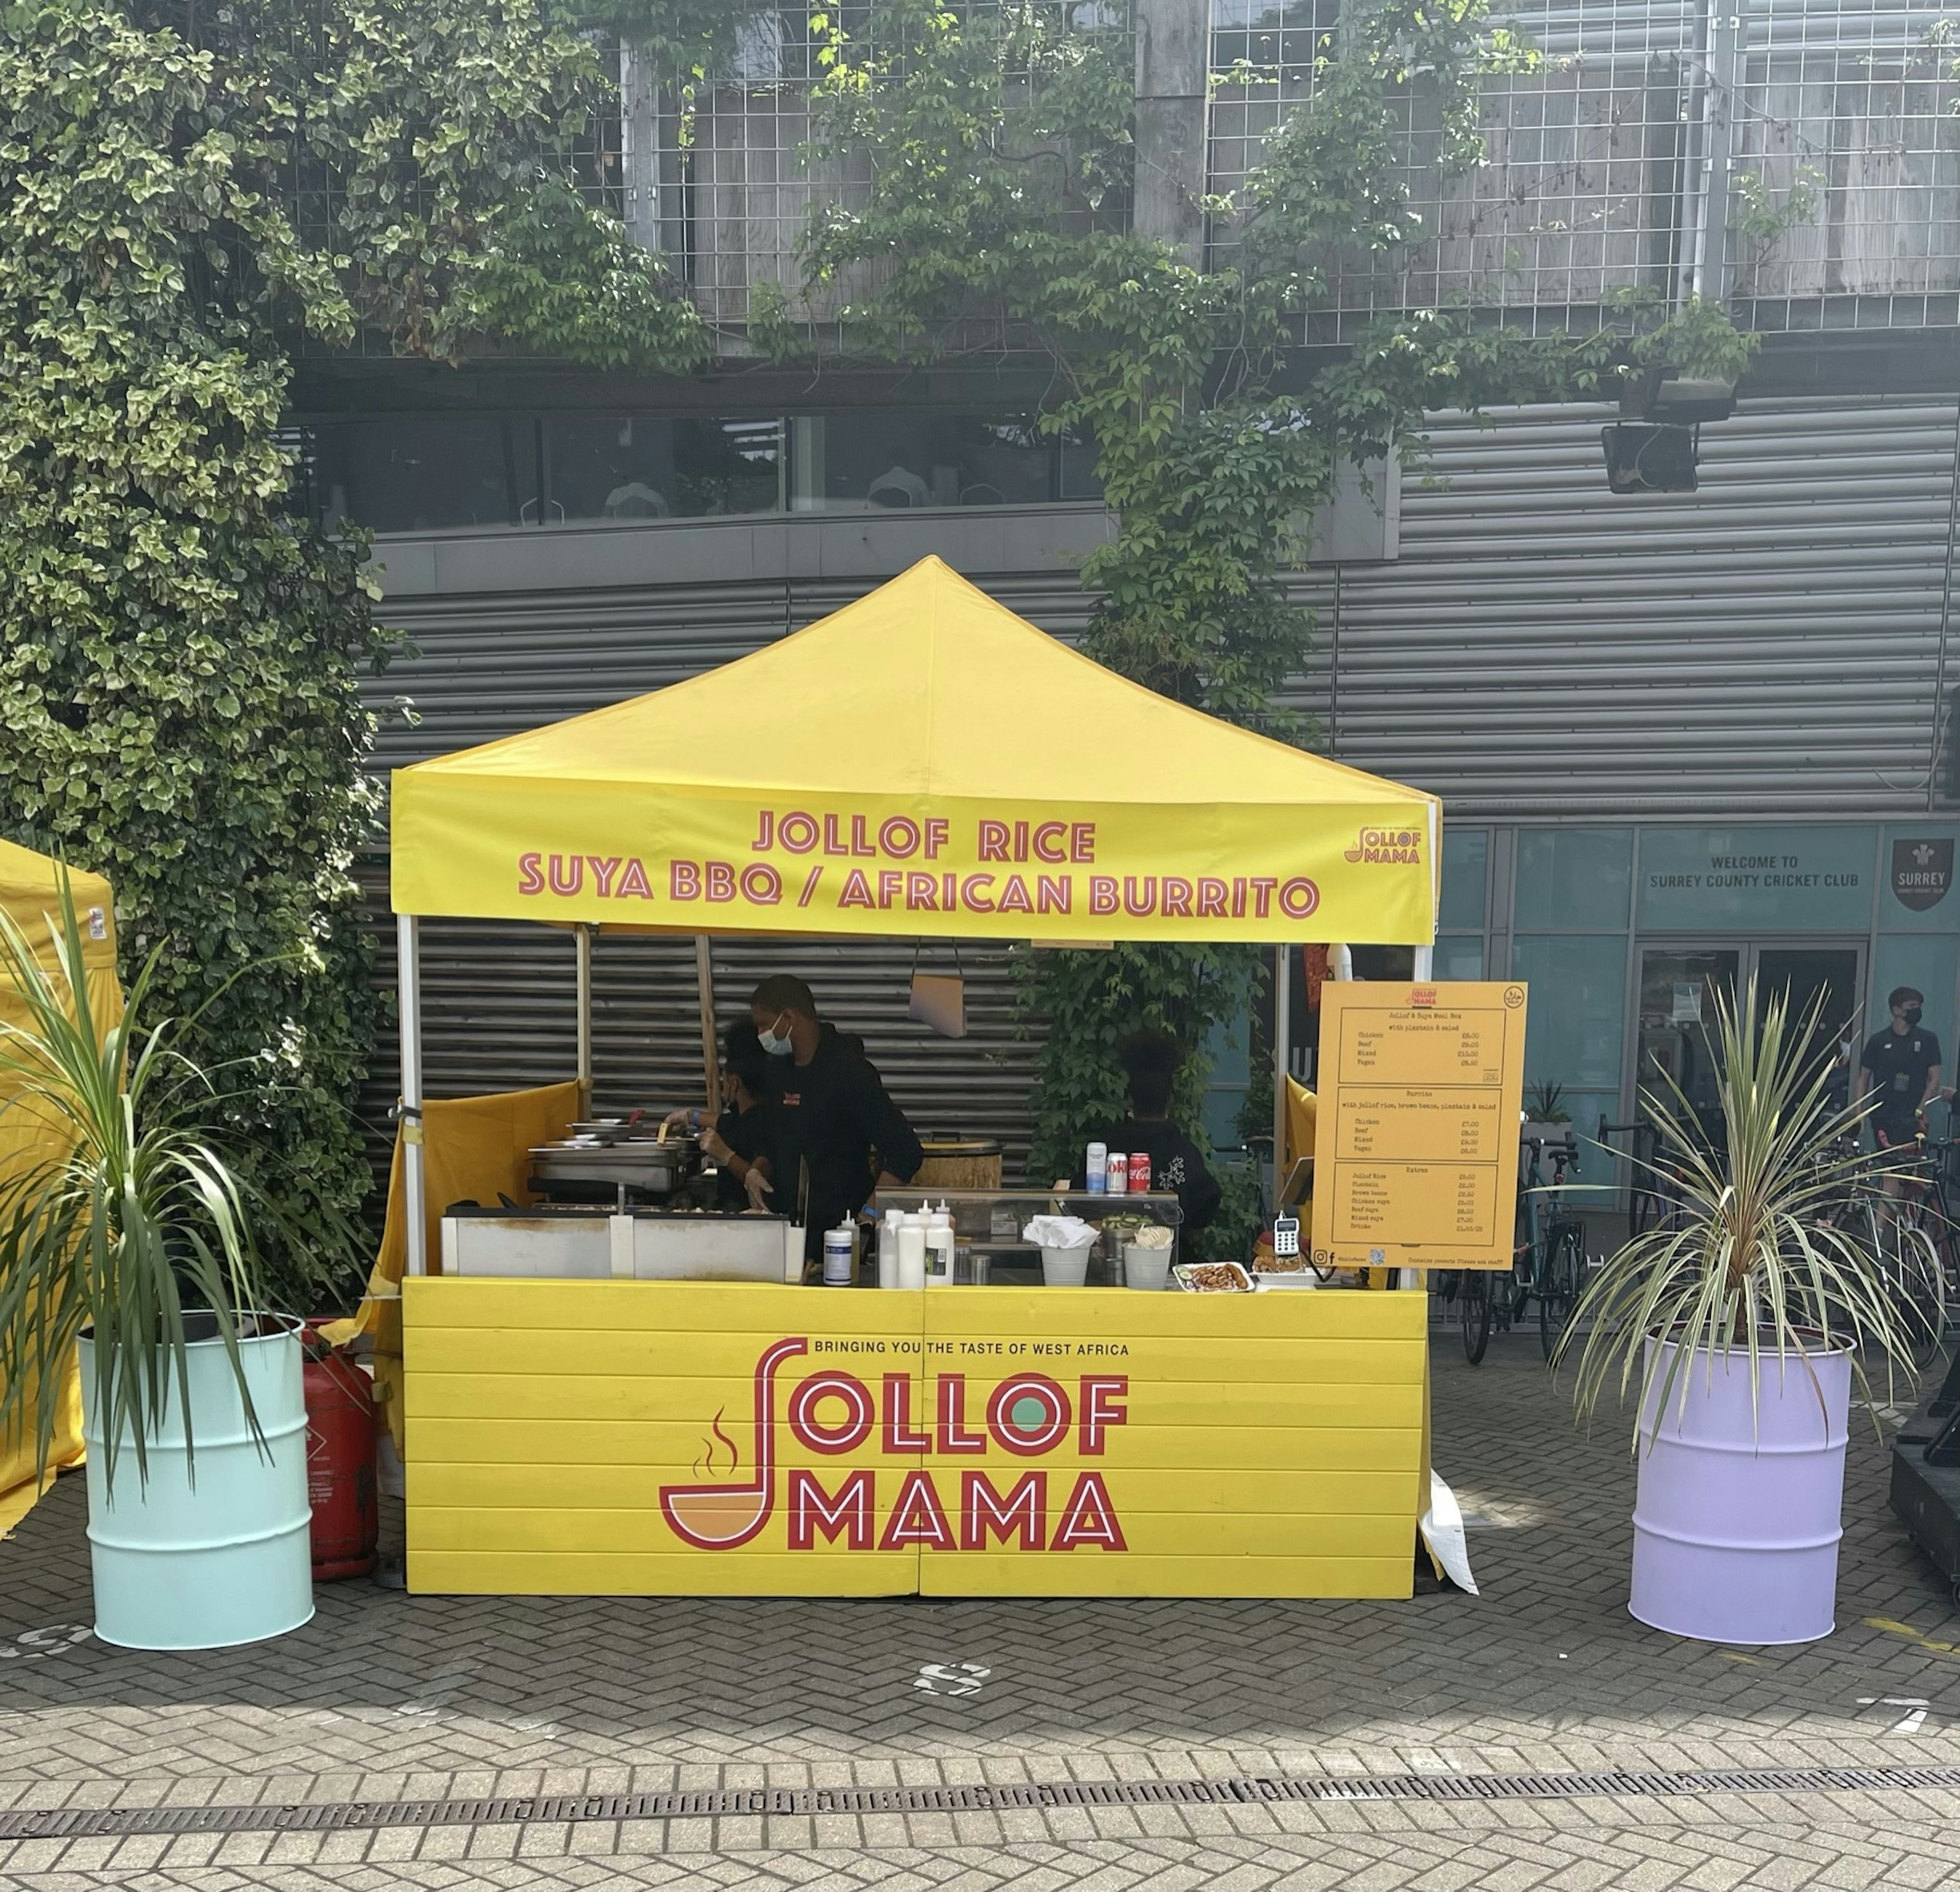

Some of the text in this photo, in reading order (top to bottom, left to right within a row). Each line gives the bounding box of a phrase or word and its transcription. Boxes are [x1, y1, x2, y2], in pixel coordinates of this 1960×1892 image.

[752, 810, 1096, 864] JOLLOF RICE
[1364, 848, 1420, 863] MAMA
[1711, 856, 1798, 868] WELCOME TO
[518, 852, 654, 900] SUYA
[670, 860, 783, 906] BBQ
[837, 867, 1071, 915] AFRICAN
[1089, 876, 1320, 920] BURRITO
[1650, 874, 1858, 888] SURREY COUNTY CRICKET CLUB
[1898, 872, 1945, 886] SURREY
[815, 1341, 1129, 1356] BRINGING YOU THE TASTE OF WEST AFRICA
[787, 1470, 1129, 1551] MAMA
